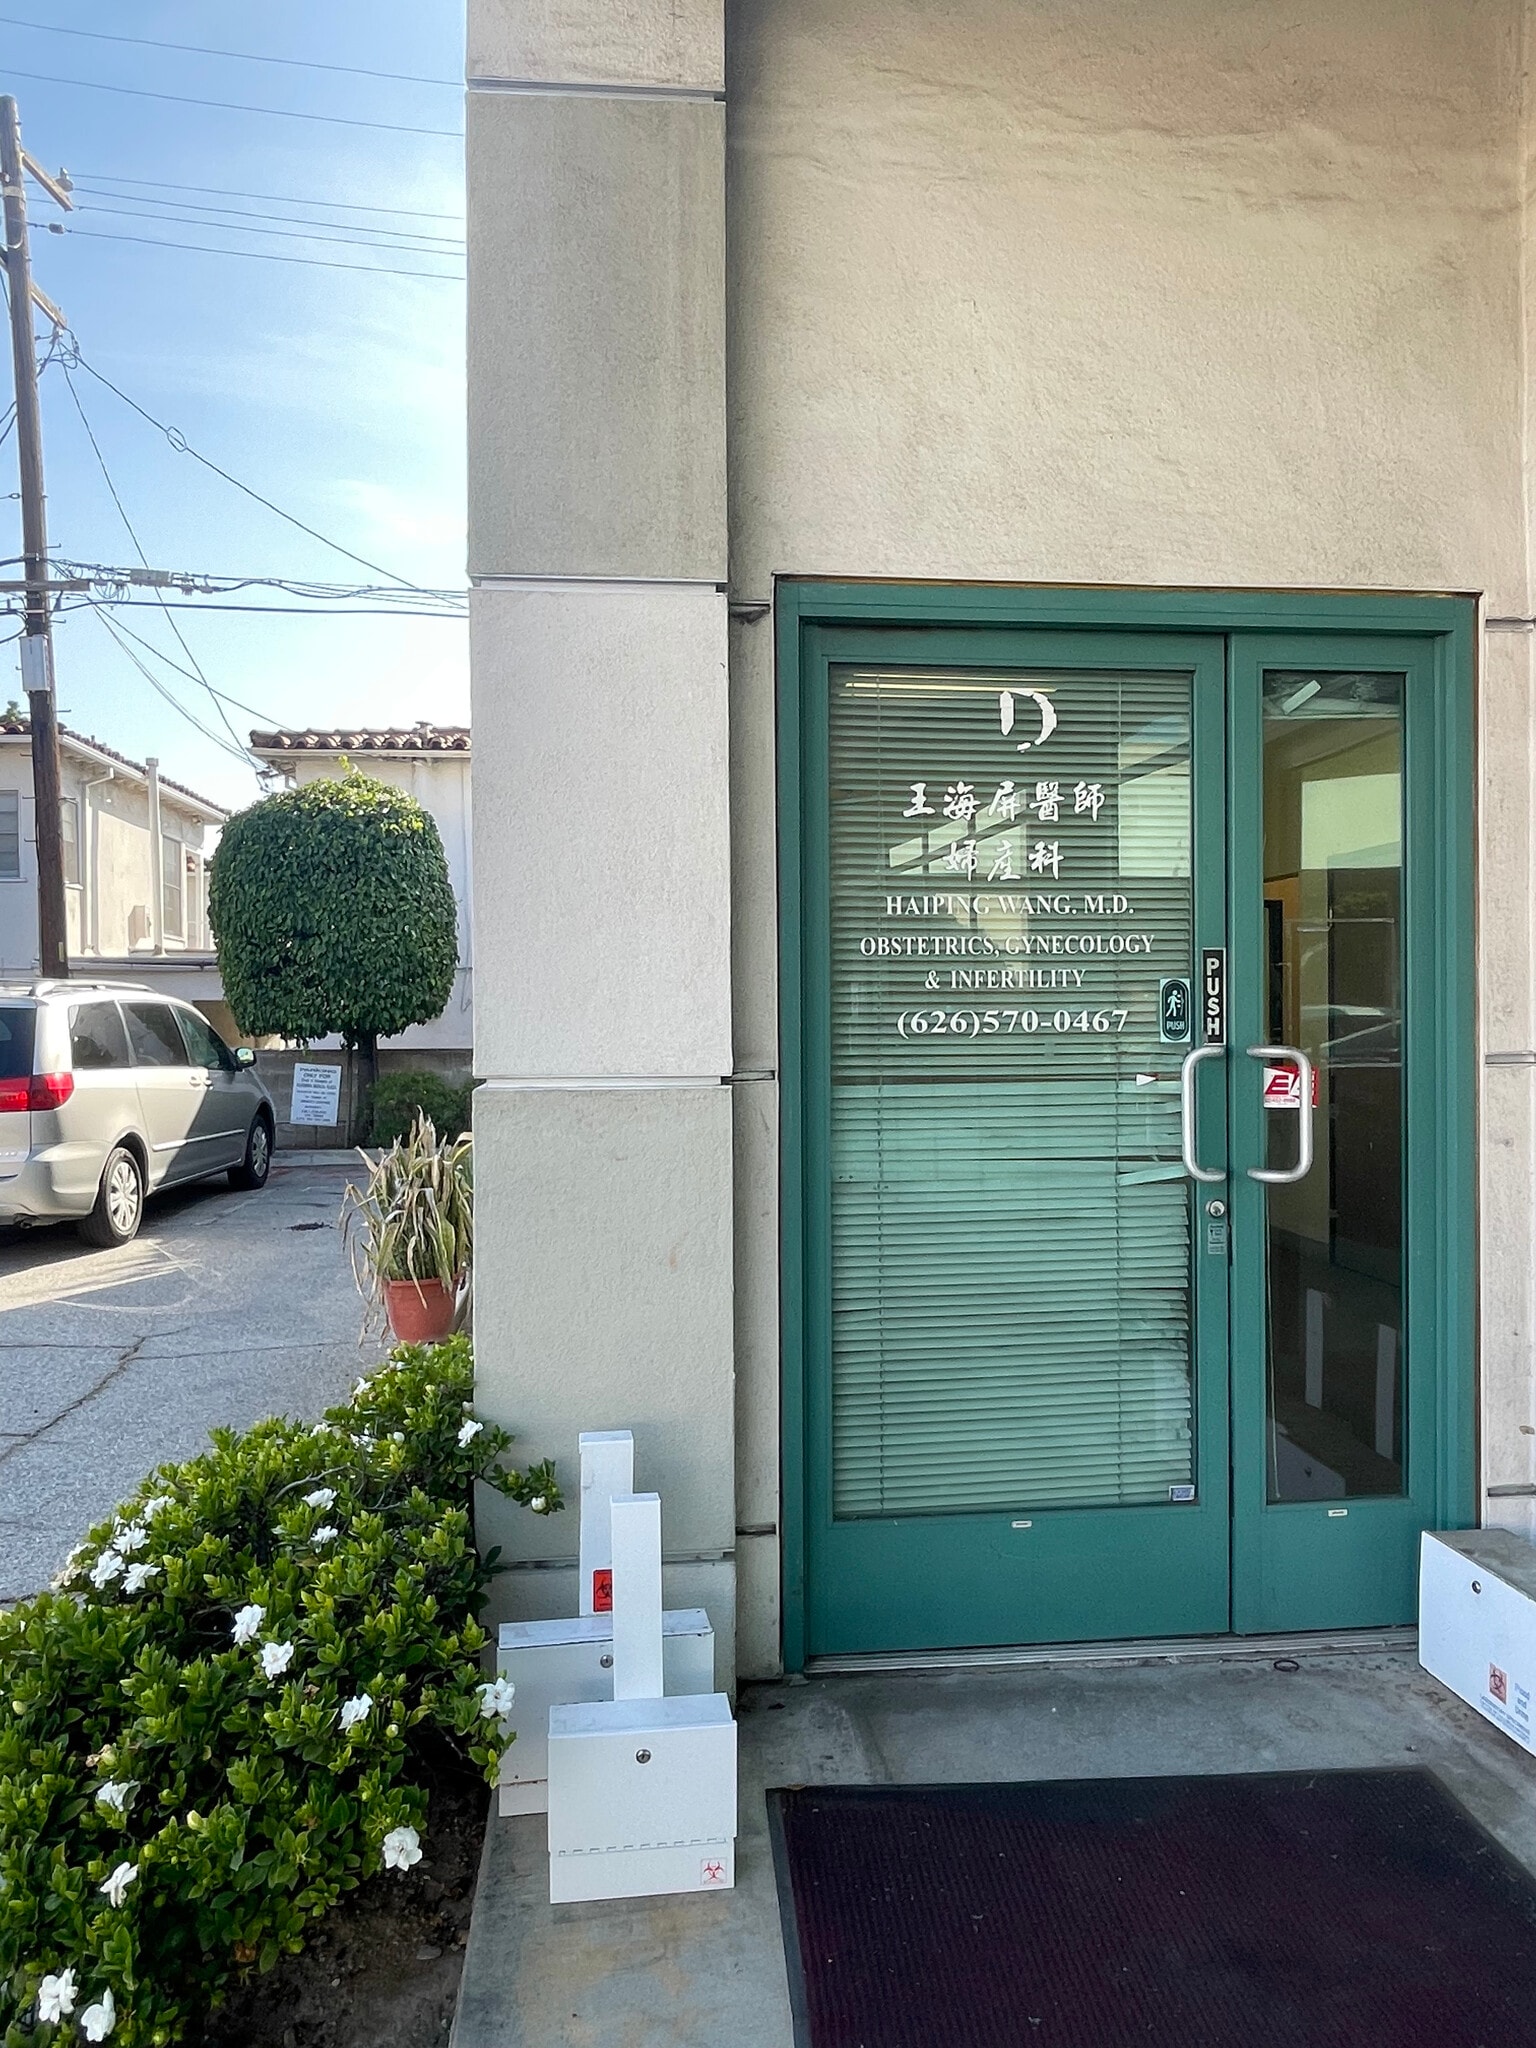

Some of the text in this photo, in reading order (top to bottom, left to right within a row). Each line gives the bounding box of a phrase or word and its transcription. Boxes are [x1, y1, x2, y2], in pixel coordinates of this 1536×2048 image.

[902, 780, 1106, 823] 王海屏醫師
[886, 894, 990, 916] HAIPING
[1083, 893, 1135, 915] M.D.
[860, 934, 1155, 958] OBSTETRICS, GYNECOLOGY
[924, 968, 1087, 990] & INFERTILITY
[1206, 957, 1220, 1036] PUSH
[897, 1008, 1129, 1040] (626)570-0467
[1166, 1020, 1185, 1031] PUSH
